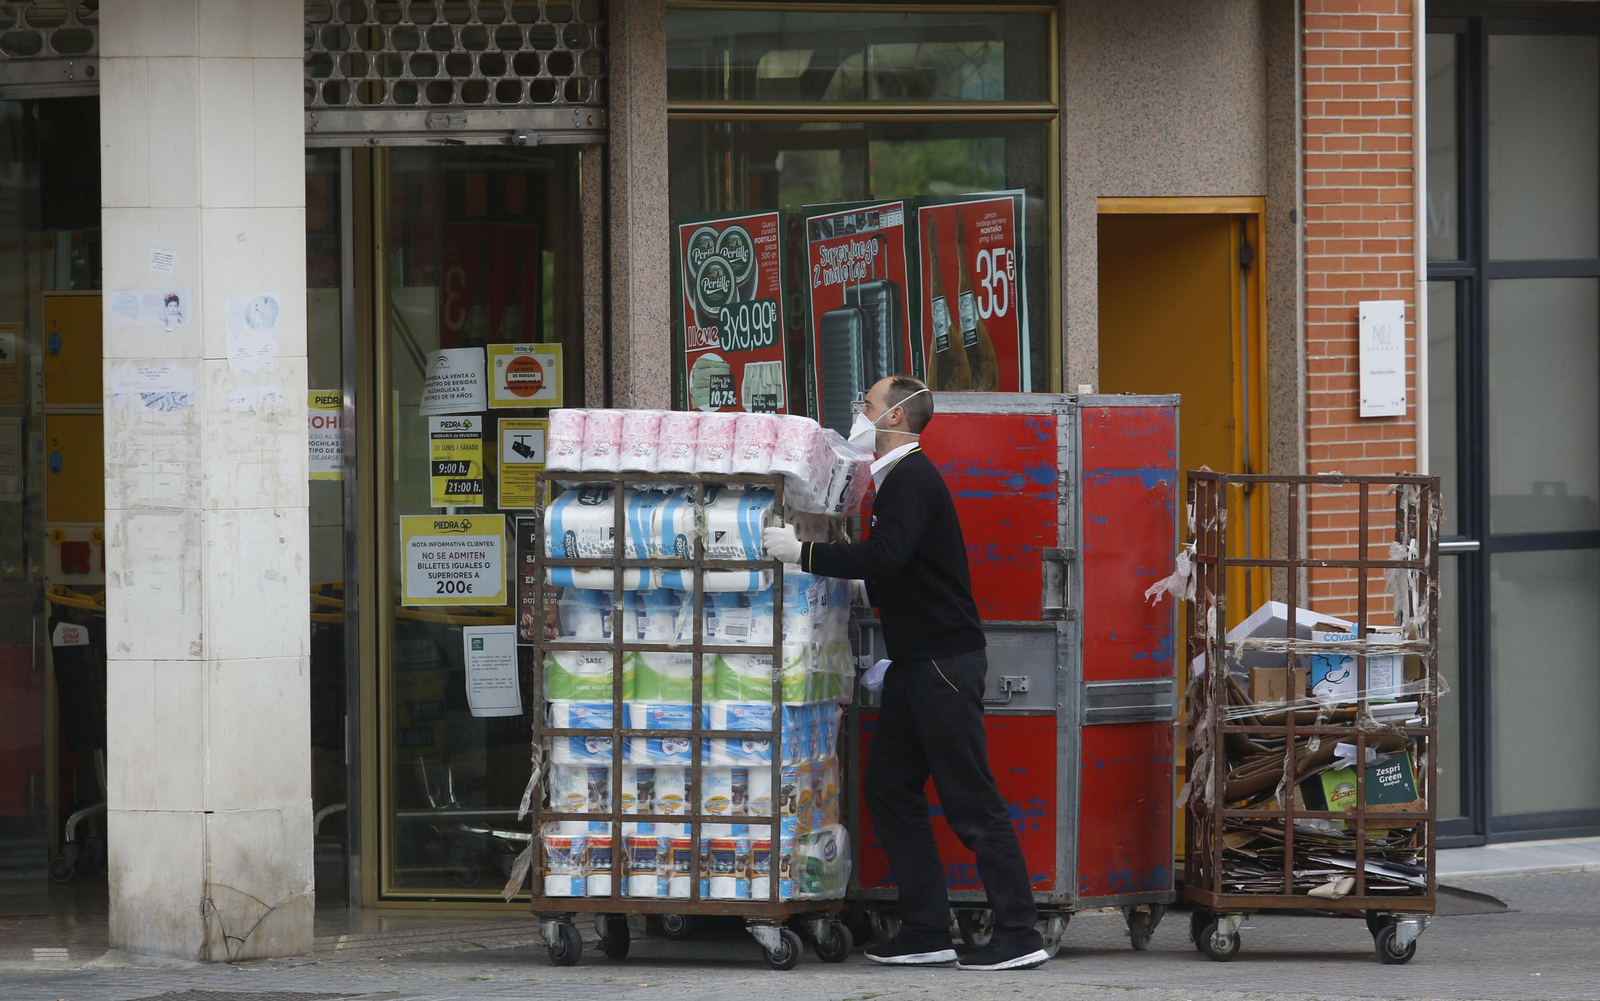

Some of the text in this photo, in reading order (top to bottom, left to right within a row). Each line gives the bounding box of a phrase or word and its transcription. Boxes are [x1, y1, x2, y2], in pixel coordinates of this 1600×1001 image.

[980, 225, 1002, 235] MONTAÑO
[754, 235, 777, 244] PORTILLO
[814, 260, 866, 288] 2 maletas
[688, 326, 719, 348] lleve
[460, 442, 479, 450] SÁBADO
[438, 462, 467, 474] 9:00 h.
[448, 481, 481, 493] 21:00 h.
[422, 551, 486, 560] NO SE ADMITEN
[418, 562, 450, 570] BILLETES
[436, 580, 473, 594] 200€
[1376, 764, 1400, 777] Zespri
[1379, 772, 1402, 783] Green
